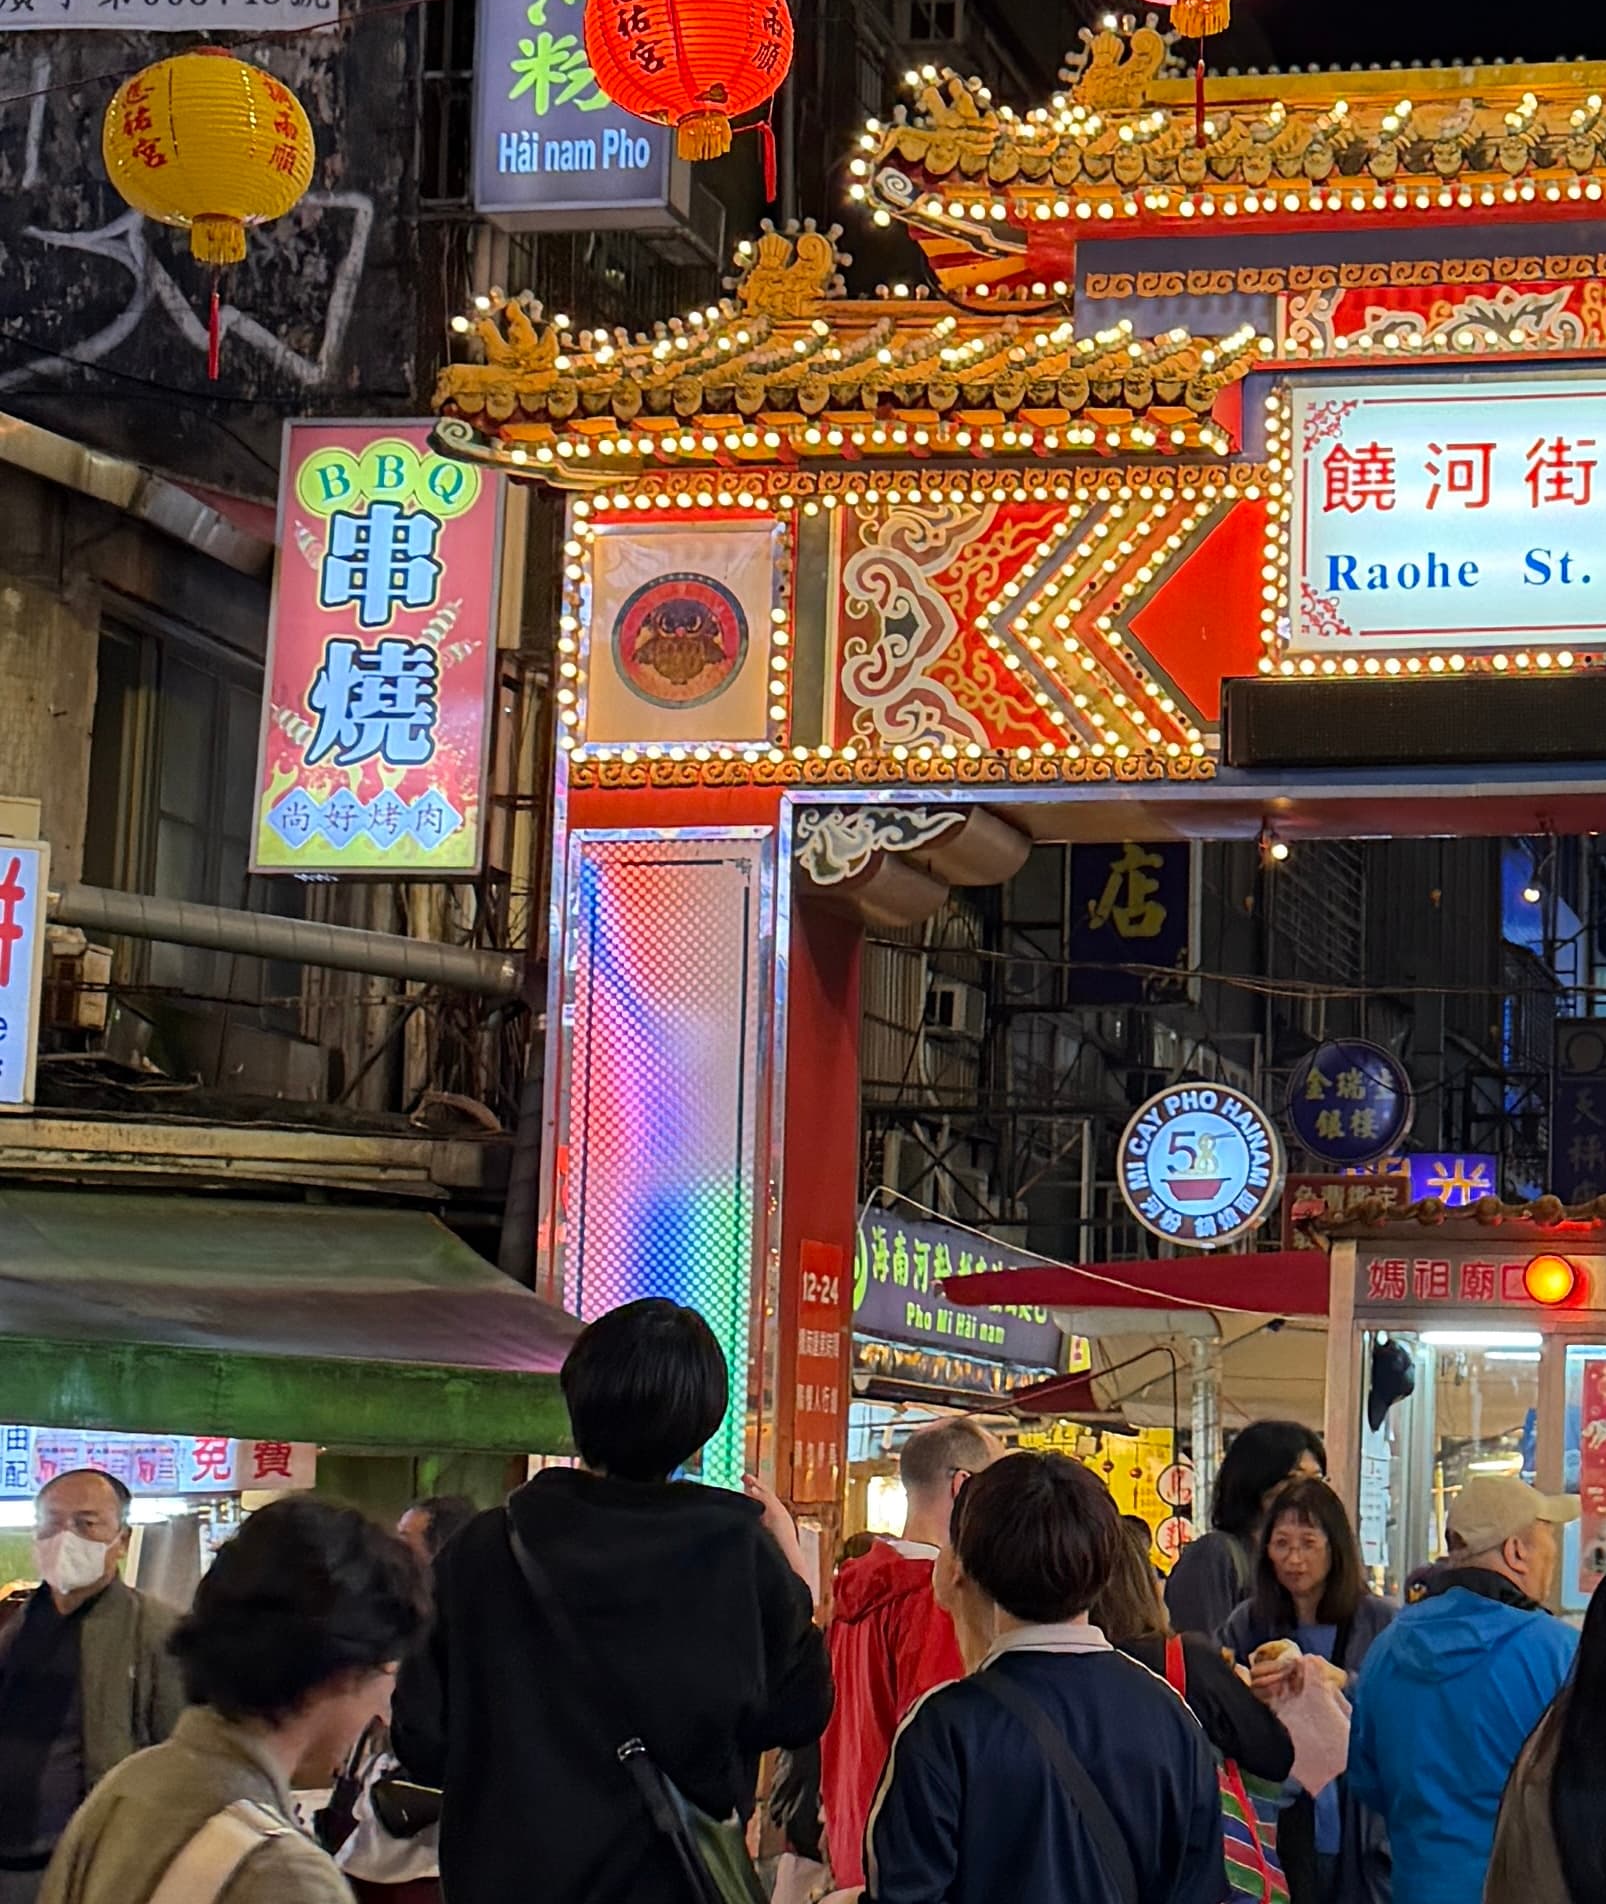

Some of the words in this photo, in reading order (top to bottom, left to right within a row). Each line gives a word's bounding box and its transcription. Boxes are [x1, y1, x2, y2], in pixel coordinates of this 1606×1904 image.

[545, 138, 596, 172] nam
[602, 128, 650, 169] Pho
[316, 453, 464, 502] BBQ
[1325, 551, 1482, 592] Raohe
[1523, 547, 1592, 587] St.
[304, 500, 443, 767] 串燒
[281, 802, 446, 835] 尚好烤肉
[1087, 843, 1168, 938] 店
[1128, 1107, 1163, 1156] CAY
[1164, 1090, 1218, 1116] PHO
[1220, 1097, 1271, 1188] HAINAM
[1368, 1259, 1529, 1302] 媽祖廟口
